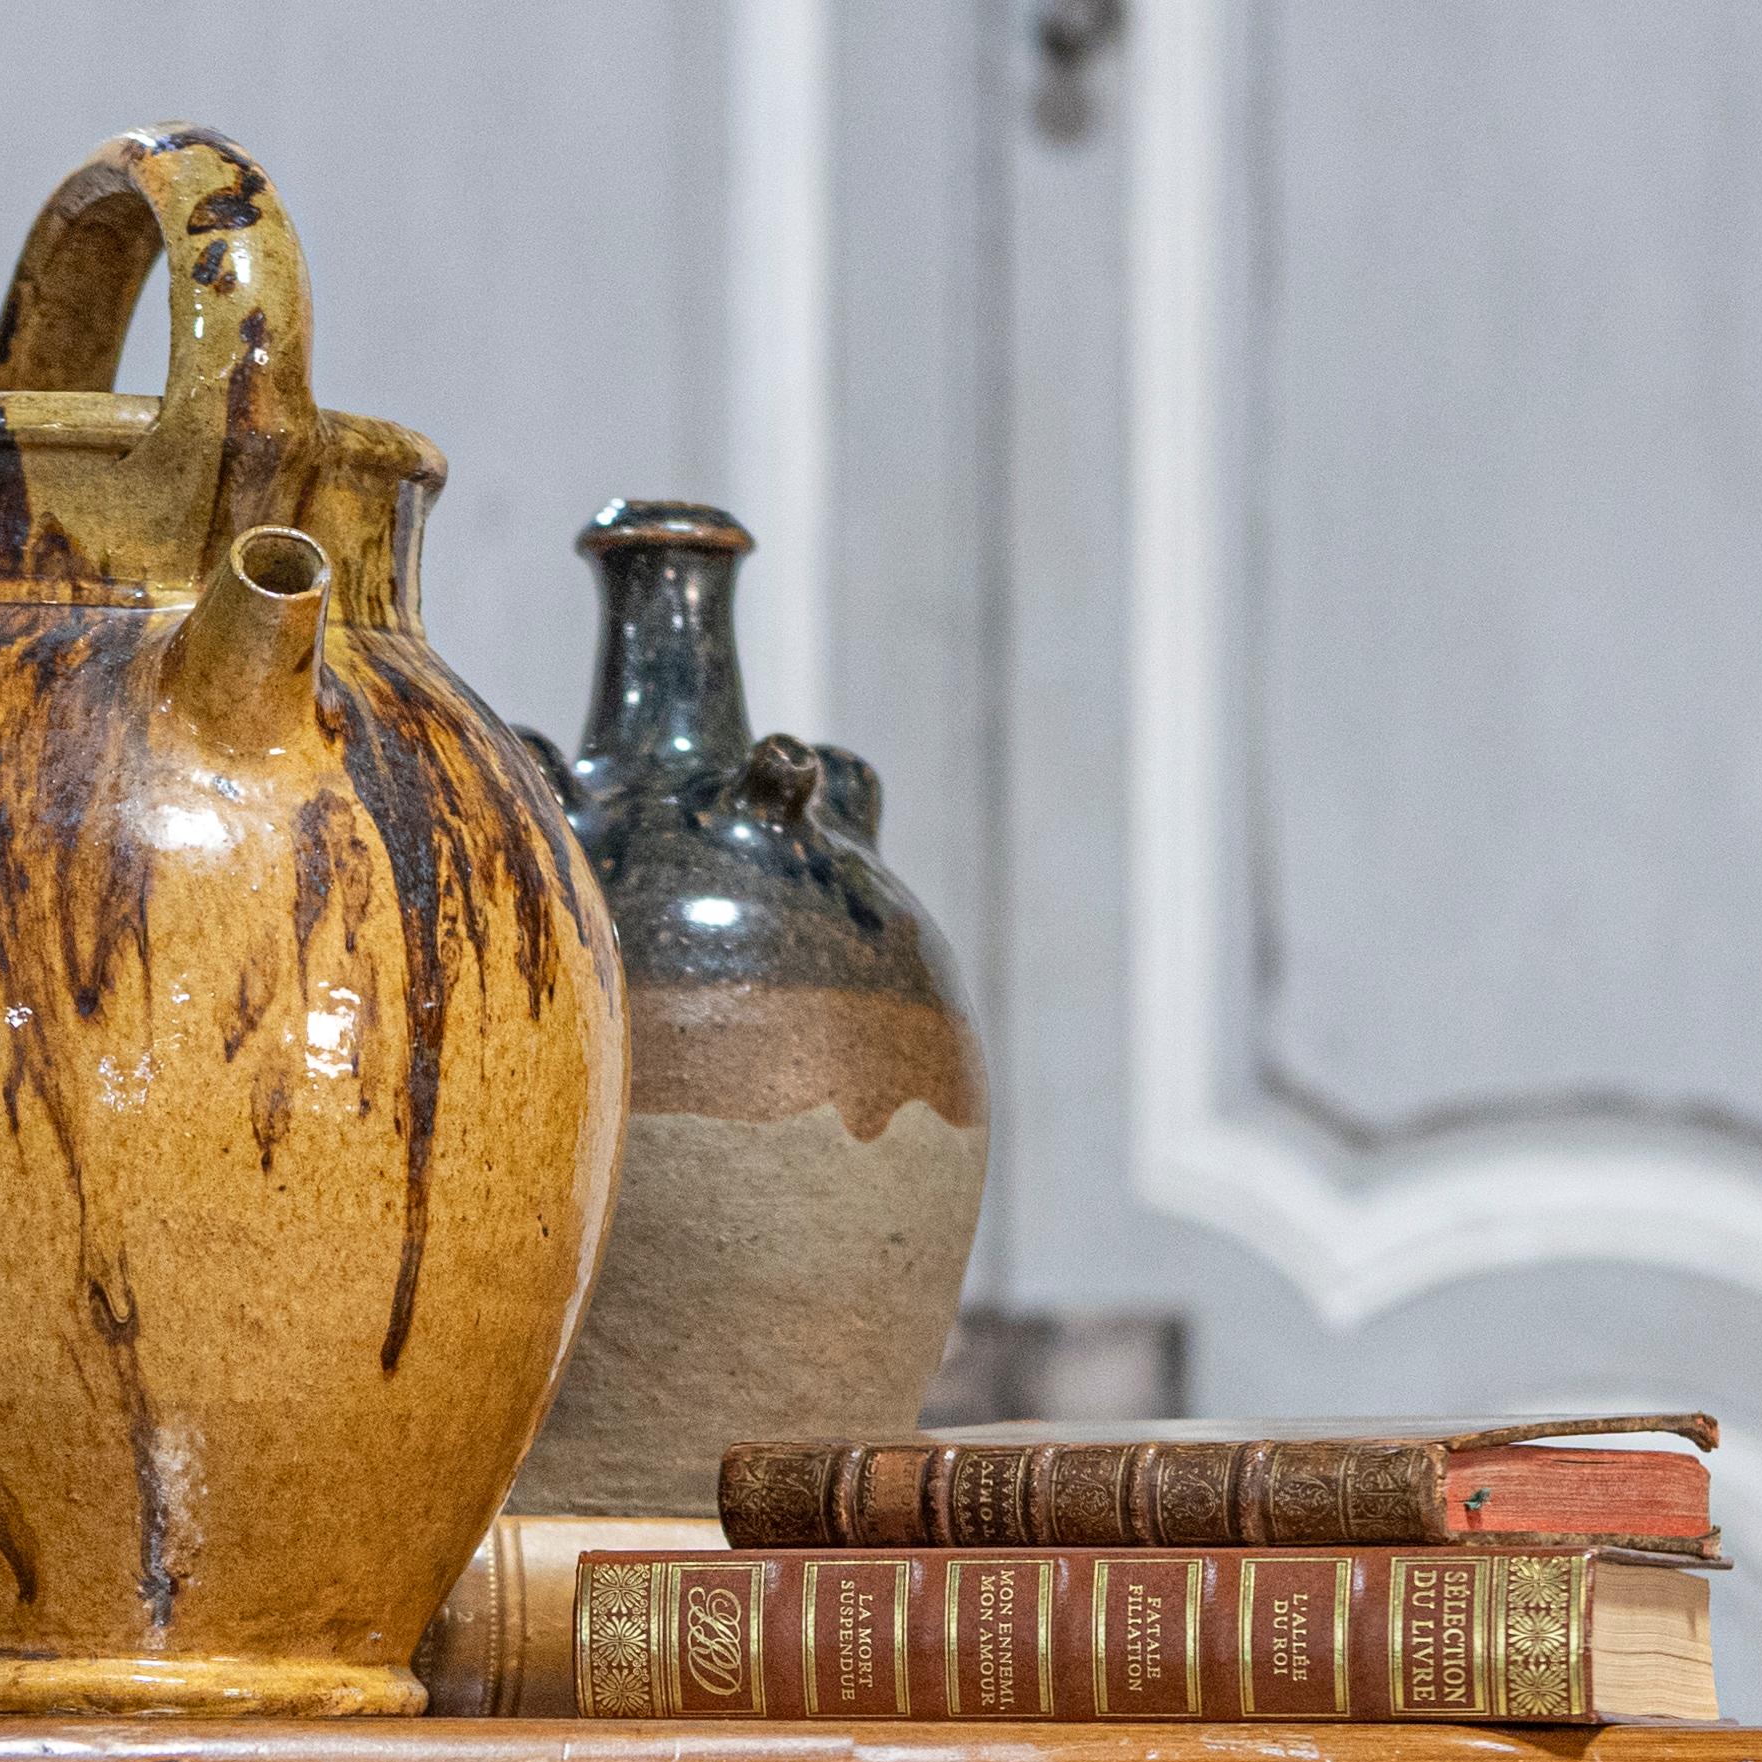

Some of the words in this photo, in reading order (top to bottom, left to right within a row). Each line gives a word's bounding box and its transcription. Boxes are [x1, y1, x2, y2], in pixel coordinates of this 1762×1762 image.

[858, 1593, 873, 1622] LA
[980, 1575, 996, 1621] MON
[999, 1569, 1015, 1616] MON
[1273, 1599, 1289, 1631] DU
[1411, 1570, 1438, 1610] DU
[840, 1579, 856, 1701] SUSPENDUE
[858, 1628, 873, 1688] MORT
[979, 1628, 996, 1707] AMOUR
[998, 1622, 1015, 1711] ENNEMI,
[1127, 1584, 1144, 1692] FILIATION
[1147, 1596, 1162, 1680] FATALE
[1273, 1637, 1288, 1675] ROI
[1292, 1592, 1310, 1682] L'ALLÉE
[1411, 1620, 1437, 1702] LIVRE
[1442, 1570, 1471, 1704] SÉLECTION
